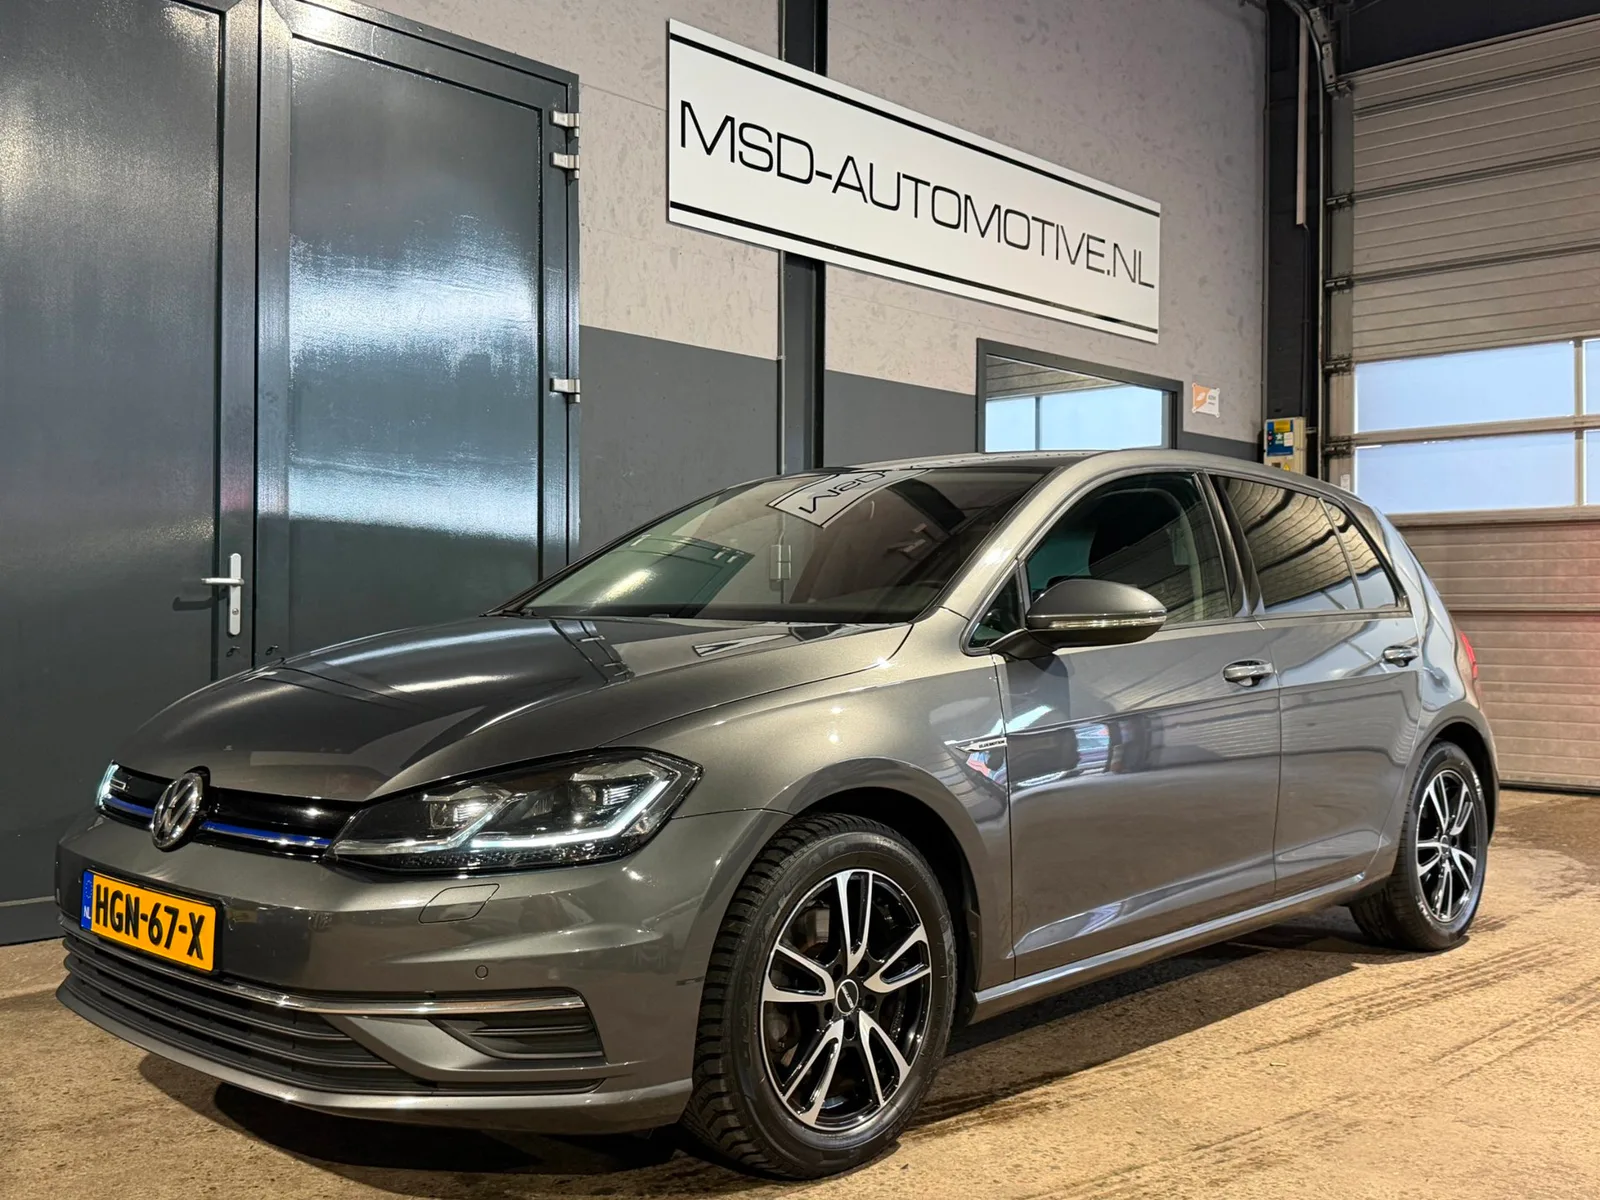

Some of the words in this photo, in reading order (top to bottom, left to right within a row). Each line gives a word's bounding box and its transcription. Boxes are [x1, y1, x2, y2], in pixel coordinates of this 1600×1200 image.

[680, 100, 1155, 289] MSD-AUTOMOTIVE.NL
[83, 905, 92, 920] NL
[95, 884, 206, 960] HGN-67-X
